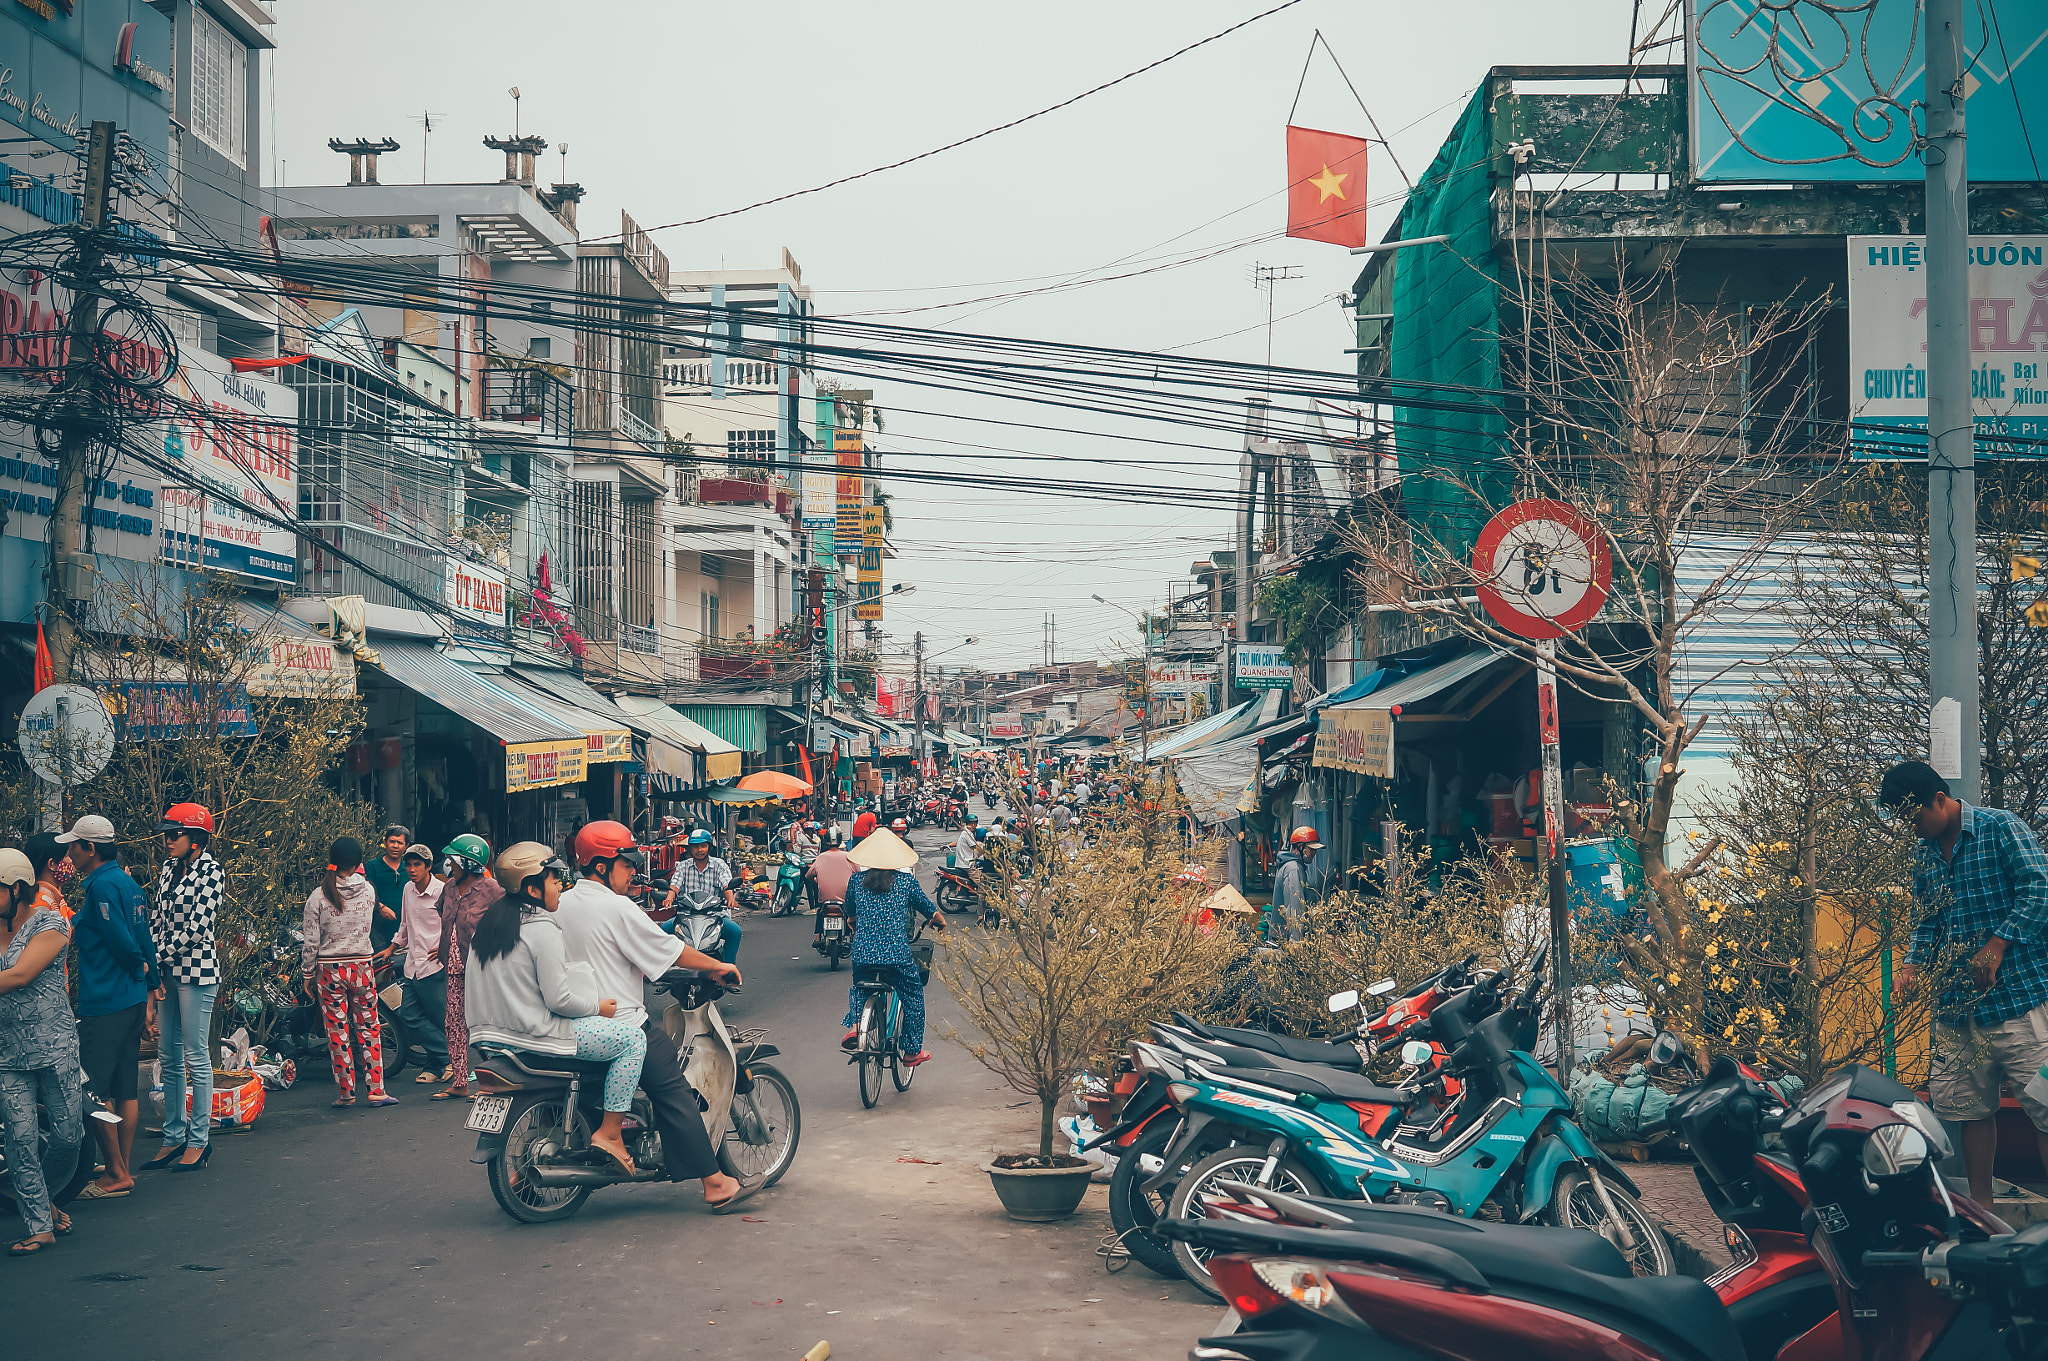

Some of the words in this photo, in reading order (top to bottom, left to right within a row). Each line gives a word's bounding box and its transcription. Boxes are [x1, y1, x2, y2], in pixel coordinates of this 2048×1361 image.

[1868, 242, 1927, 271] HIỆ
[1864, 363, 1926, 399] CHUYÊN
[2014, 362, 2037, 382] Bạt
[243, 381, 266, 409] HÀNG
[2022, 422, 2038, 435] P1
[807, 503, 830, 514] GIANG
[217, 520, 234, 540] TÙNG
[858, 540, 881, 571] CHÍN
[456, 564, 471, 608] ÚT
[473, 578, 503, 618] HẠNH
[272, 641, 282, 667] 9
[285, 643, 333, 671] KHANH
[1240, 667, 1267, 677] QUANG
[477, 1098, 506, 1114] 63-F9
[472, 1113, 500, 1130] 1873
[1490, 1133, 1526, 1143] HONDA
